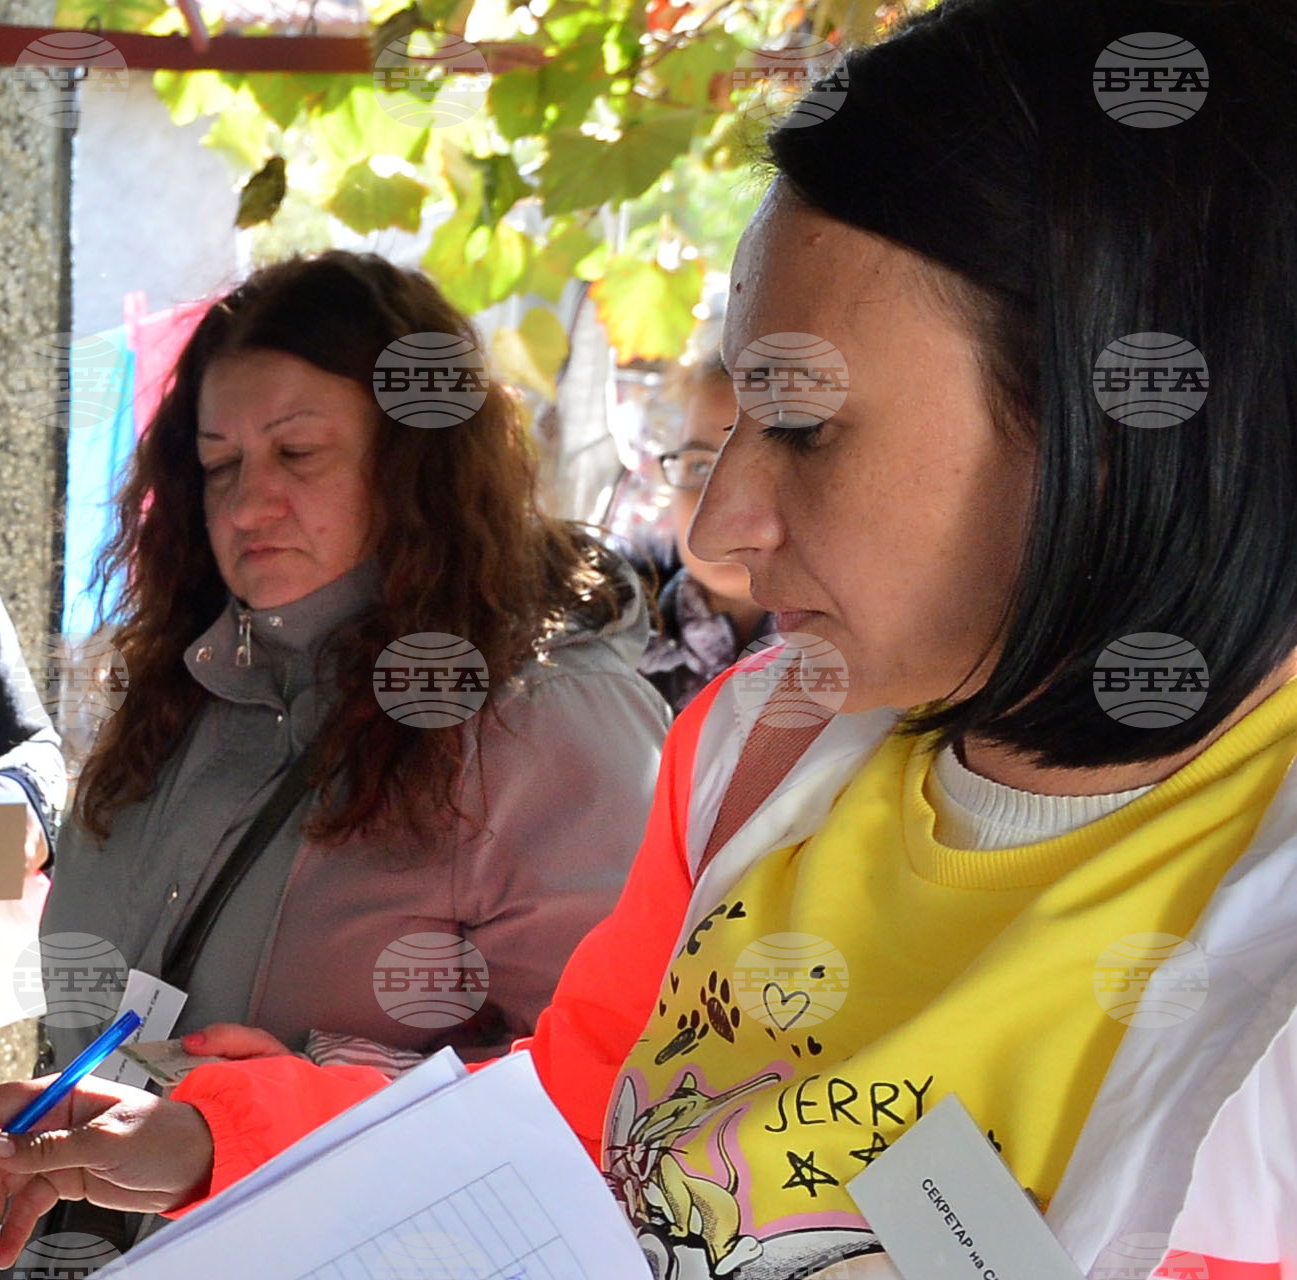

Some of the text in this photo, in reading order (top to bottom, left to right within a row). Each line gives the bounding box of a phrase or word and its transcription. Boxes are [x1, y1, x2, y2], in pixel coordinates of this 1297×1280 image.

[764, 1074, 933, 1132] JERRY
[922, 1178, 973, 1248] СЕКРЕТАР
[969, 1251, 985, 1269] на
